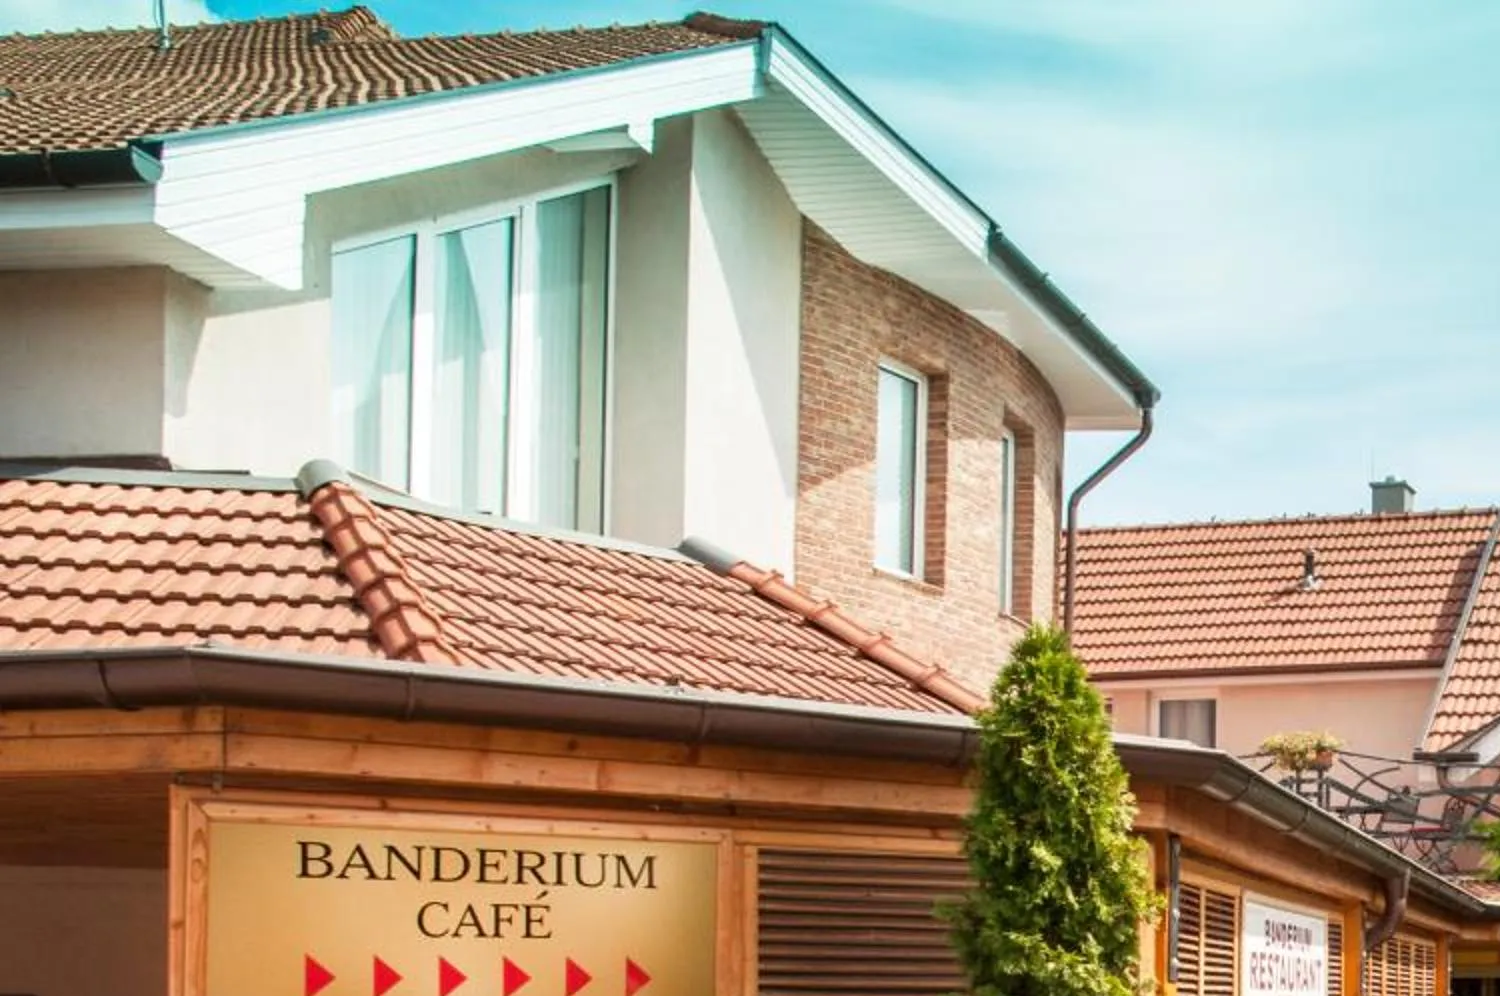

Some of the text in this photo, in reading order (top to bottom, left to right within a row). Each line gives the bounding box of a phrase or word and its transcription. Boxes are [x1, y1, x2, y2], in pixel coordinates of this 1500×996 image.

[296, 841, 657, 889] BANDERIUM
[416, 890, 553, 939] CAFÉ
[1249, 951, 1322, 992] RESTAURANT
